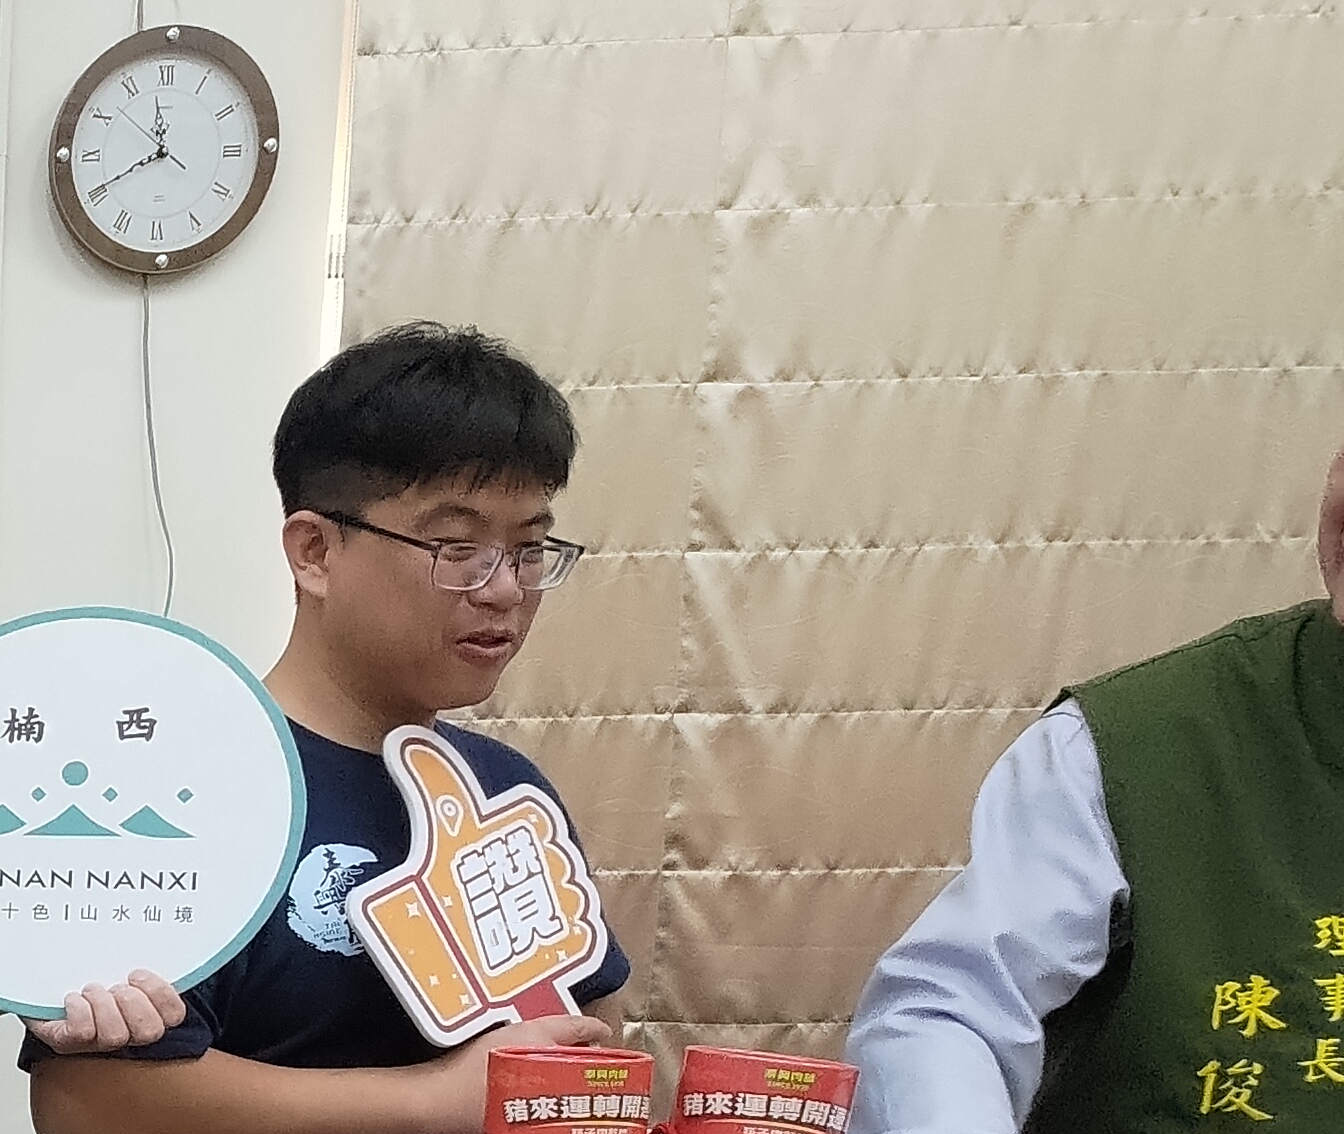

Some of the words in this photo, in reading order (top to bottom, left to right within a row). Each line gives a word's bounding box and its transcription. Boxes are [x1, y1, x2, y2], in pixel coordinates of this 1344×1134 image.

[2, 706, 158, 745] 楠西
[85, 868, 199, 892] NANXI
[457, 826, 565, 970] 讚
[1297, 914, 1344, 1084] 理事長
[683, 1092, 848, 1131] 豬來運轉開運
